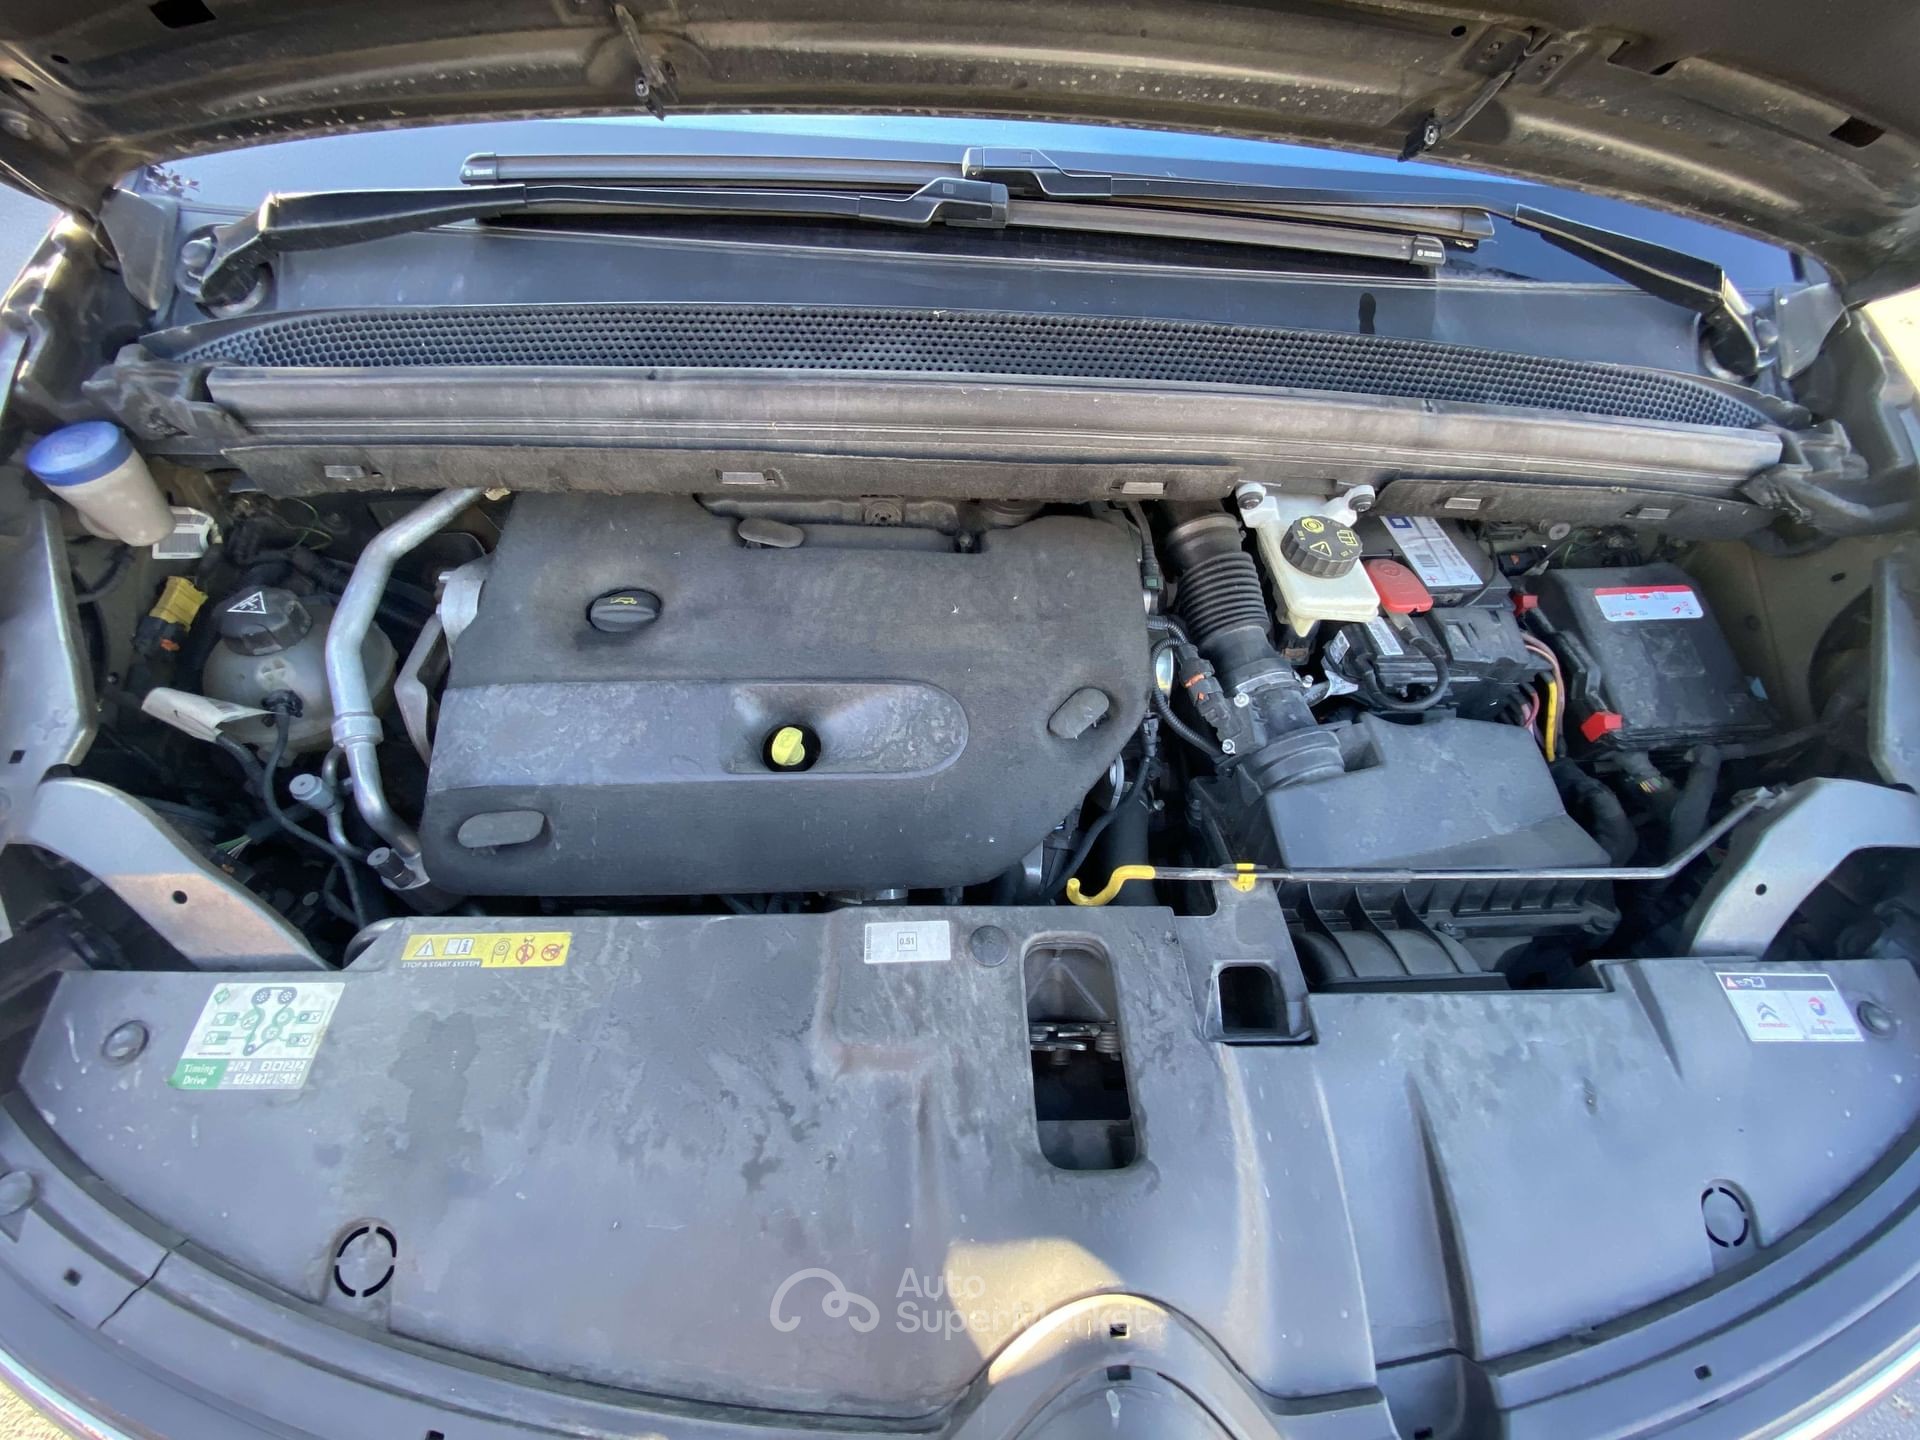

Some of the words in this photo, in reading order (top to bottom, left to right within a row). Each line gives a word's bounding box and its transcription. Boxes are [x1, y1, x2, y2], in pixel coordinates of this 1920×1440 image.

[402, 961, 421, 969] STOP
[452, 960, 480, 968] SYSTEM
[184, 1064, 217, 1075] Timing
[182, 1075, 207, 1085] Drive
